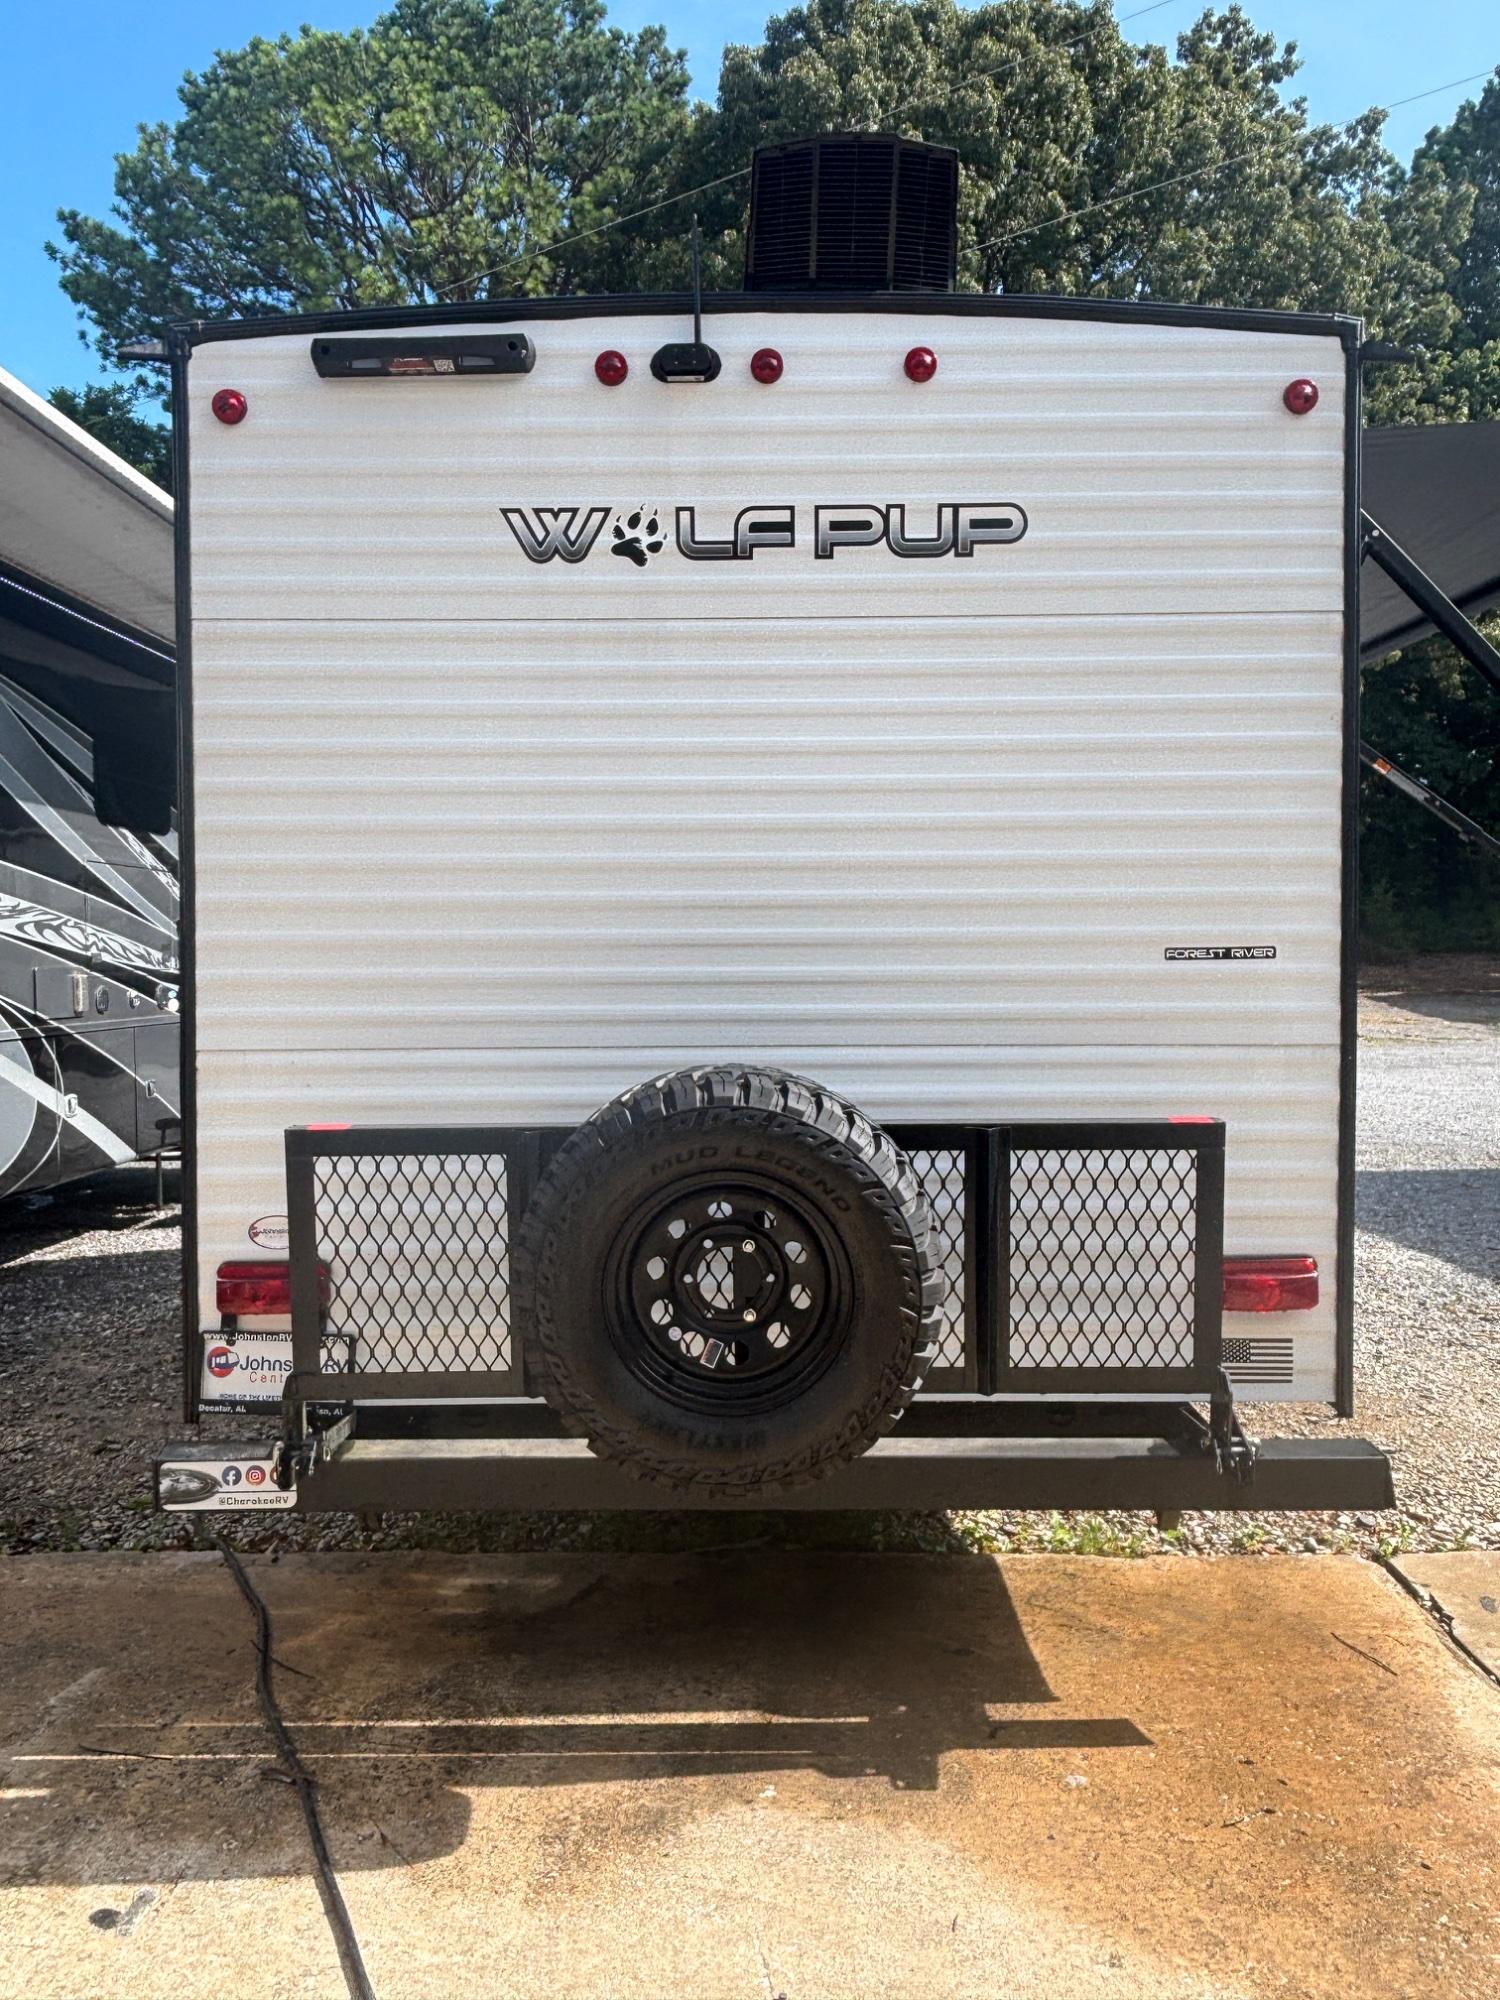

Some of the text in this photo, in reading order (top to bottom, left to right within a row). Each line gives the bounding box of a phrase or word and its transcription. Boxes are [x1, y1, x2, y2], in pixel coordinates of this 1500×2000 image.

[814, 502, 1028, 559] PUP
[1166, 947, 1275, 959] FOREST RIVER
[651, 1145, 850, 1212] MUD LEGEND
[239, 1354, 293, 1372] Johns
[249, 1371, 284, 1383] Cent
[218, 1496, 289, 1506] @CherokeeRV
